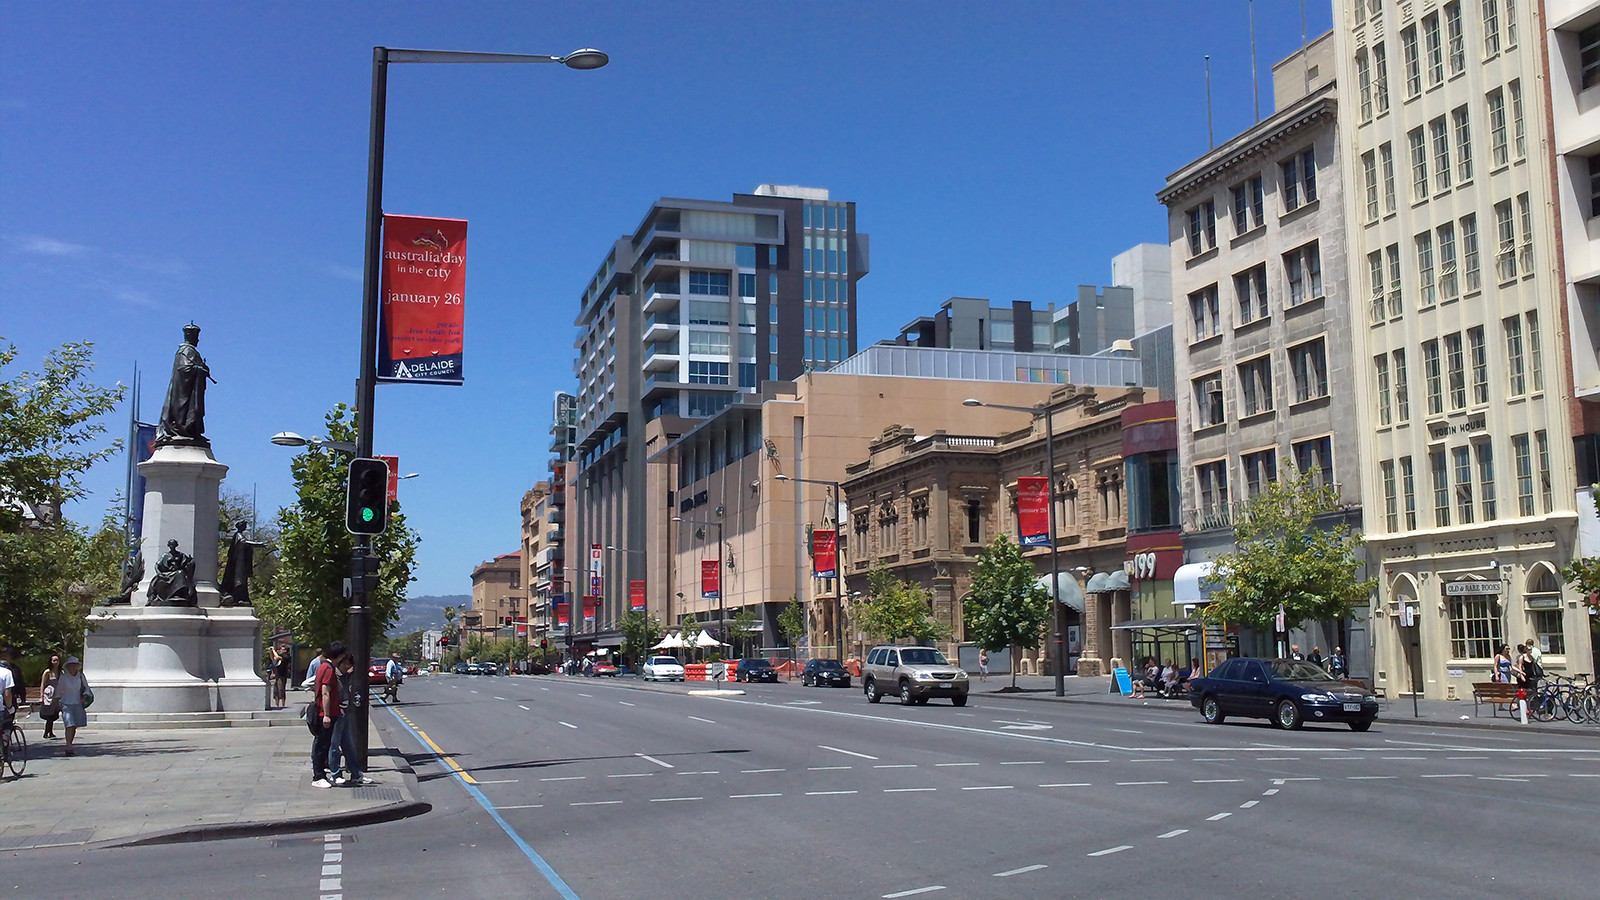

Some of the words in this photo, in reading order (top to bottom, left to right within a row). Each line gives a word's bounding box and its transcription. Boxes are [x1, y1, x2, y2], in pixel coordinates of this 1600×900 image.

[397, 264, 406, 273] in
[409, 265, 424, 274] the
[426, 265, 451, 282] city
[384, 289, 440, 307] january
[444, 292, 461, 305] 26
[1435, 426, 1456, 437] TOBIN
[1460, 419, 1486, 432] HOUSE
[1134, 552, 1156, 579] 199
[1465, 584, 1480, 592] RARE
[1481, 583, 1500, 591] BOOKS
